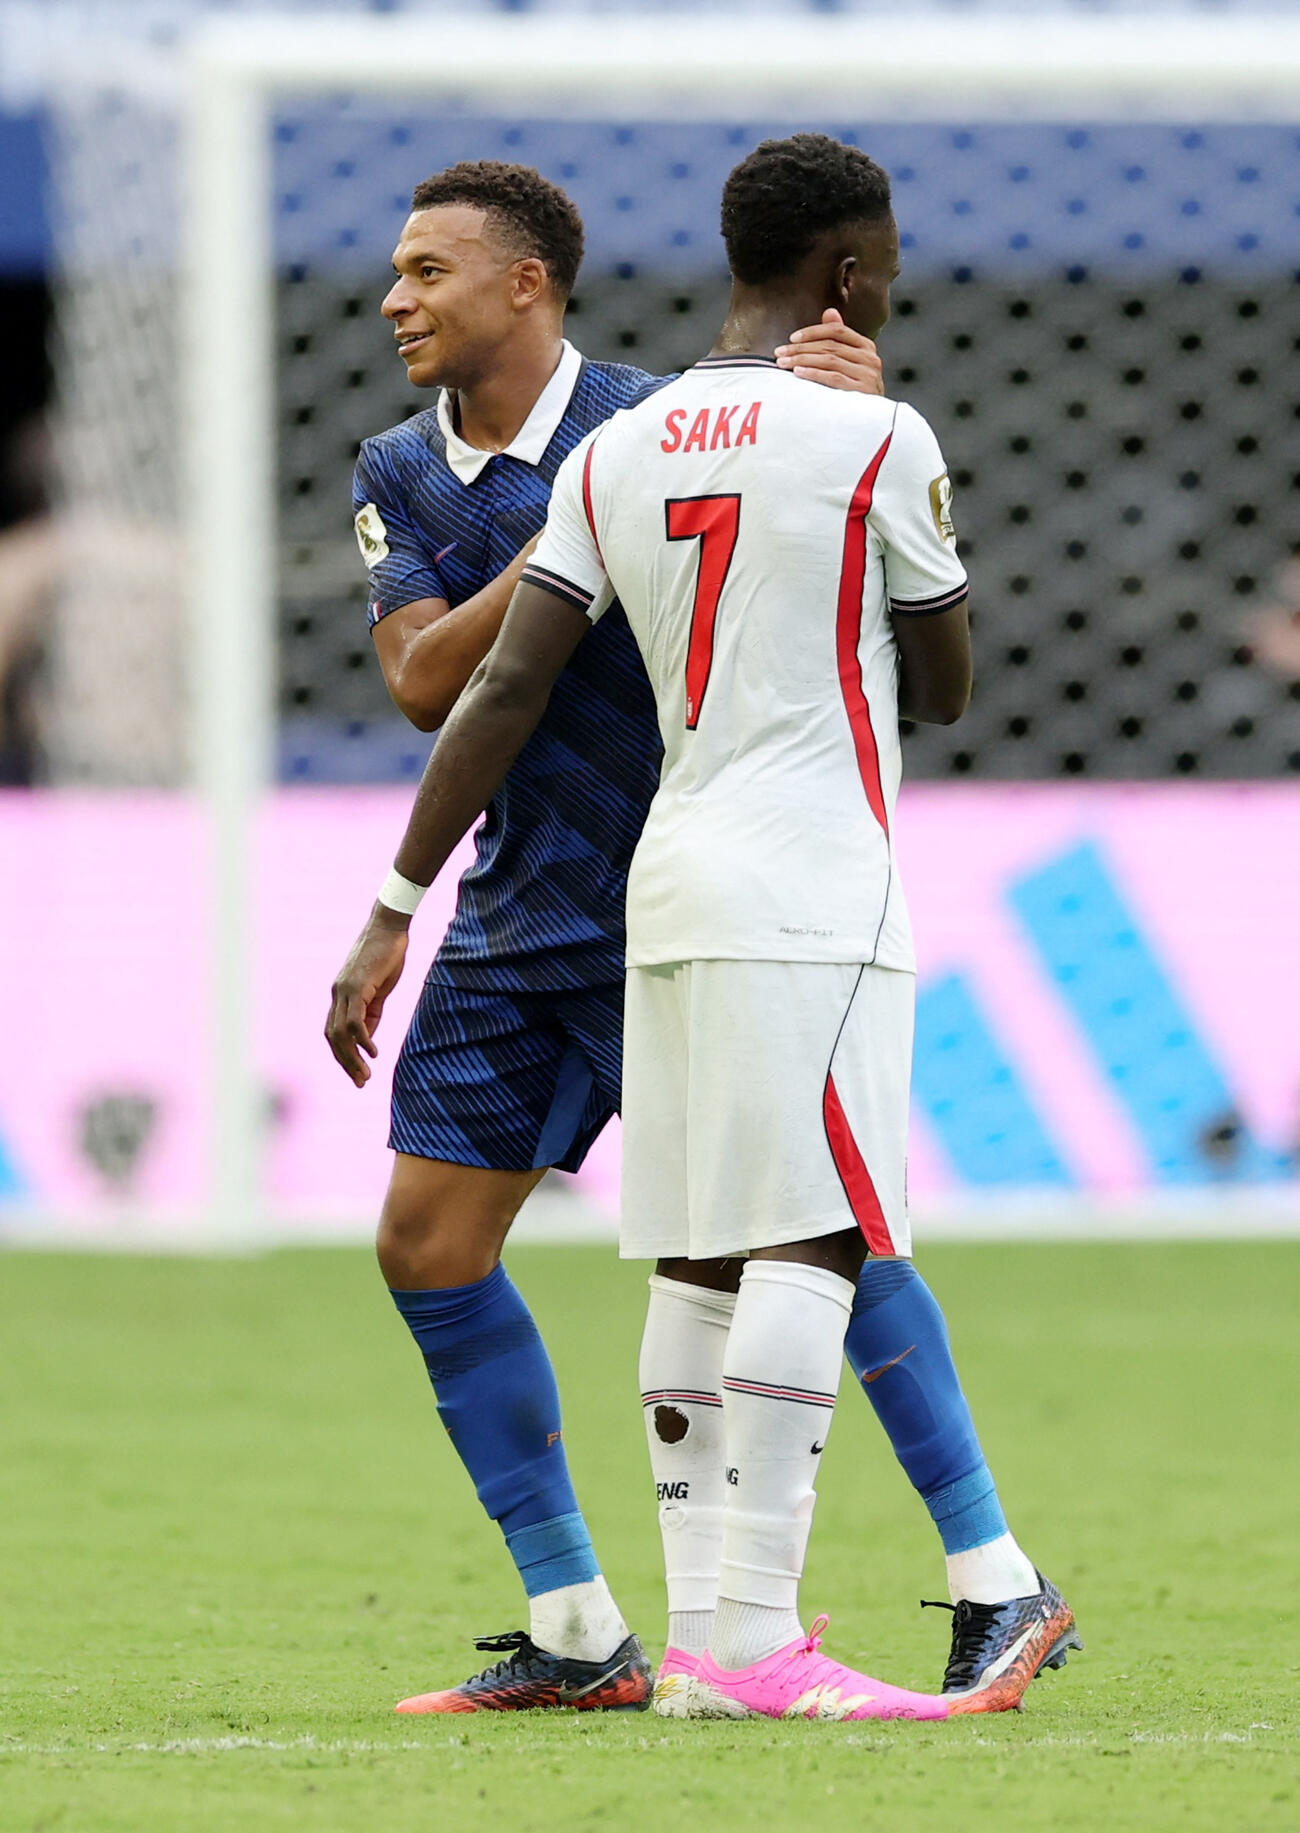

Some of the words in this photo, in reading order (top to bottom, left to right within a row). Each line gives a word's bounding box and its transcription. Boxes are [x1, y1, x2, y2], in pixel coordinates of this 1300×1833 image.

[660, 401, 762, 453] SAKA
[665, 493, 742, 731] 7
[656, 1481, 689, 1501] ENG
